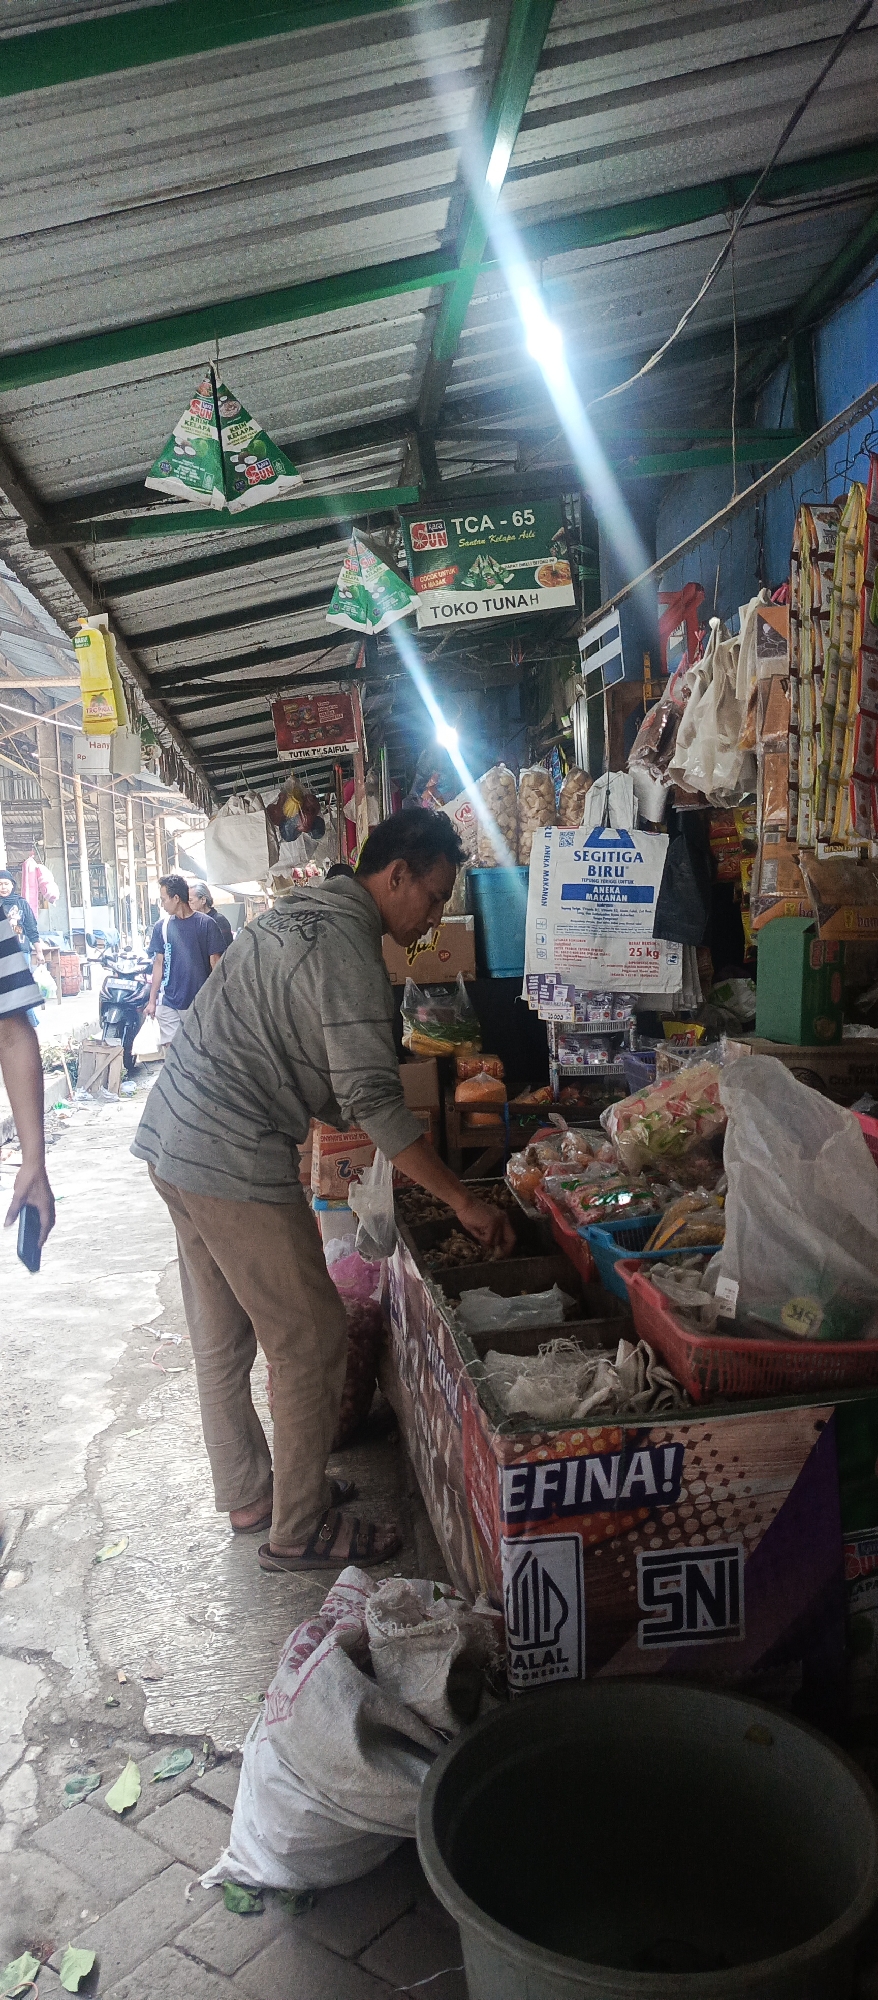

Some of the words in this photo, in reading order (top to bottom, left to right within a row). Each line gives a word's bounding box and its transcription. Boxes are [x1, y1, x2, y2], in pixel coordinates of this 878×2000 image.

[189, 399, 213, 420] SUN
[184, 420, 211, 432] KELAPA
[227, 426, 254, 441] KELAPA
[245, 463, 275, 485] SUN
[451, 515, 495, 535] TCA
[512, 509, 536, 527] 65
[411, 523, 448, 550] SUN
[458, 537, 486, 548] Santan
[489, 534, 516, 546] Kelapa
[430, 602, 478, 619] TOKO
[482, 593, 539, 612] TUNAH
[289, 750, 310, 759] TUTIK
[542, 845, 551, 868] ANEKA
[573, 850, 644, 863] SEGITIGA
[588, 865, 625, 878] BIRU
[541, 869, 550, 907] MAKANAN
[593, 886, 620, 894] ANEKA
[585, 893, 628, 902] MAKANAN
[629, 947, 642, 957] 25
[646, 947, 660, 960] kg
[498, 1448, 677, 1512] EFINA!
[643, 1558, 740, 1634] SNI
[509, 1665, 569, 1681] DONESIA
